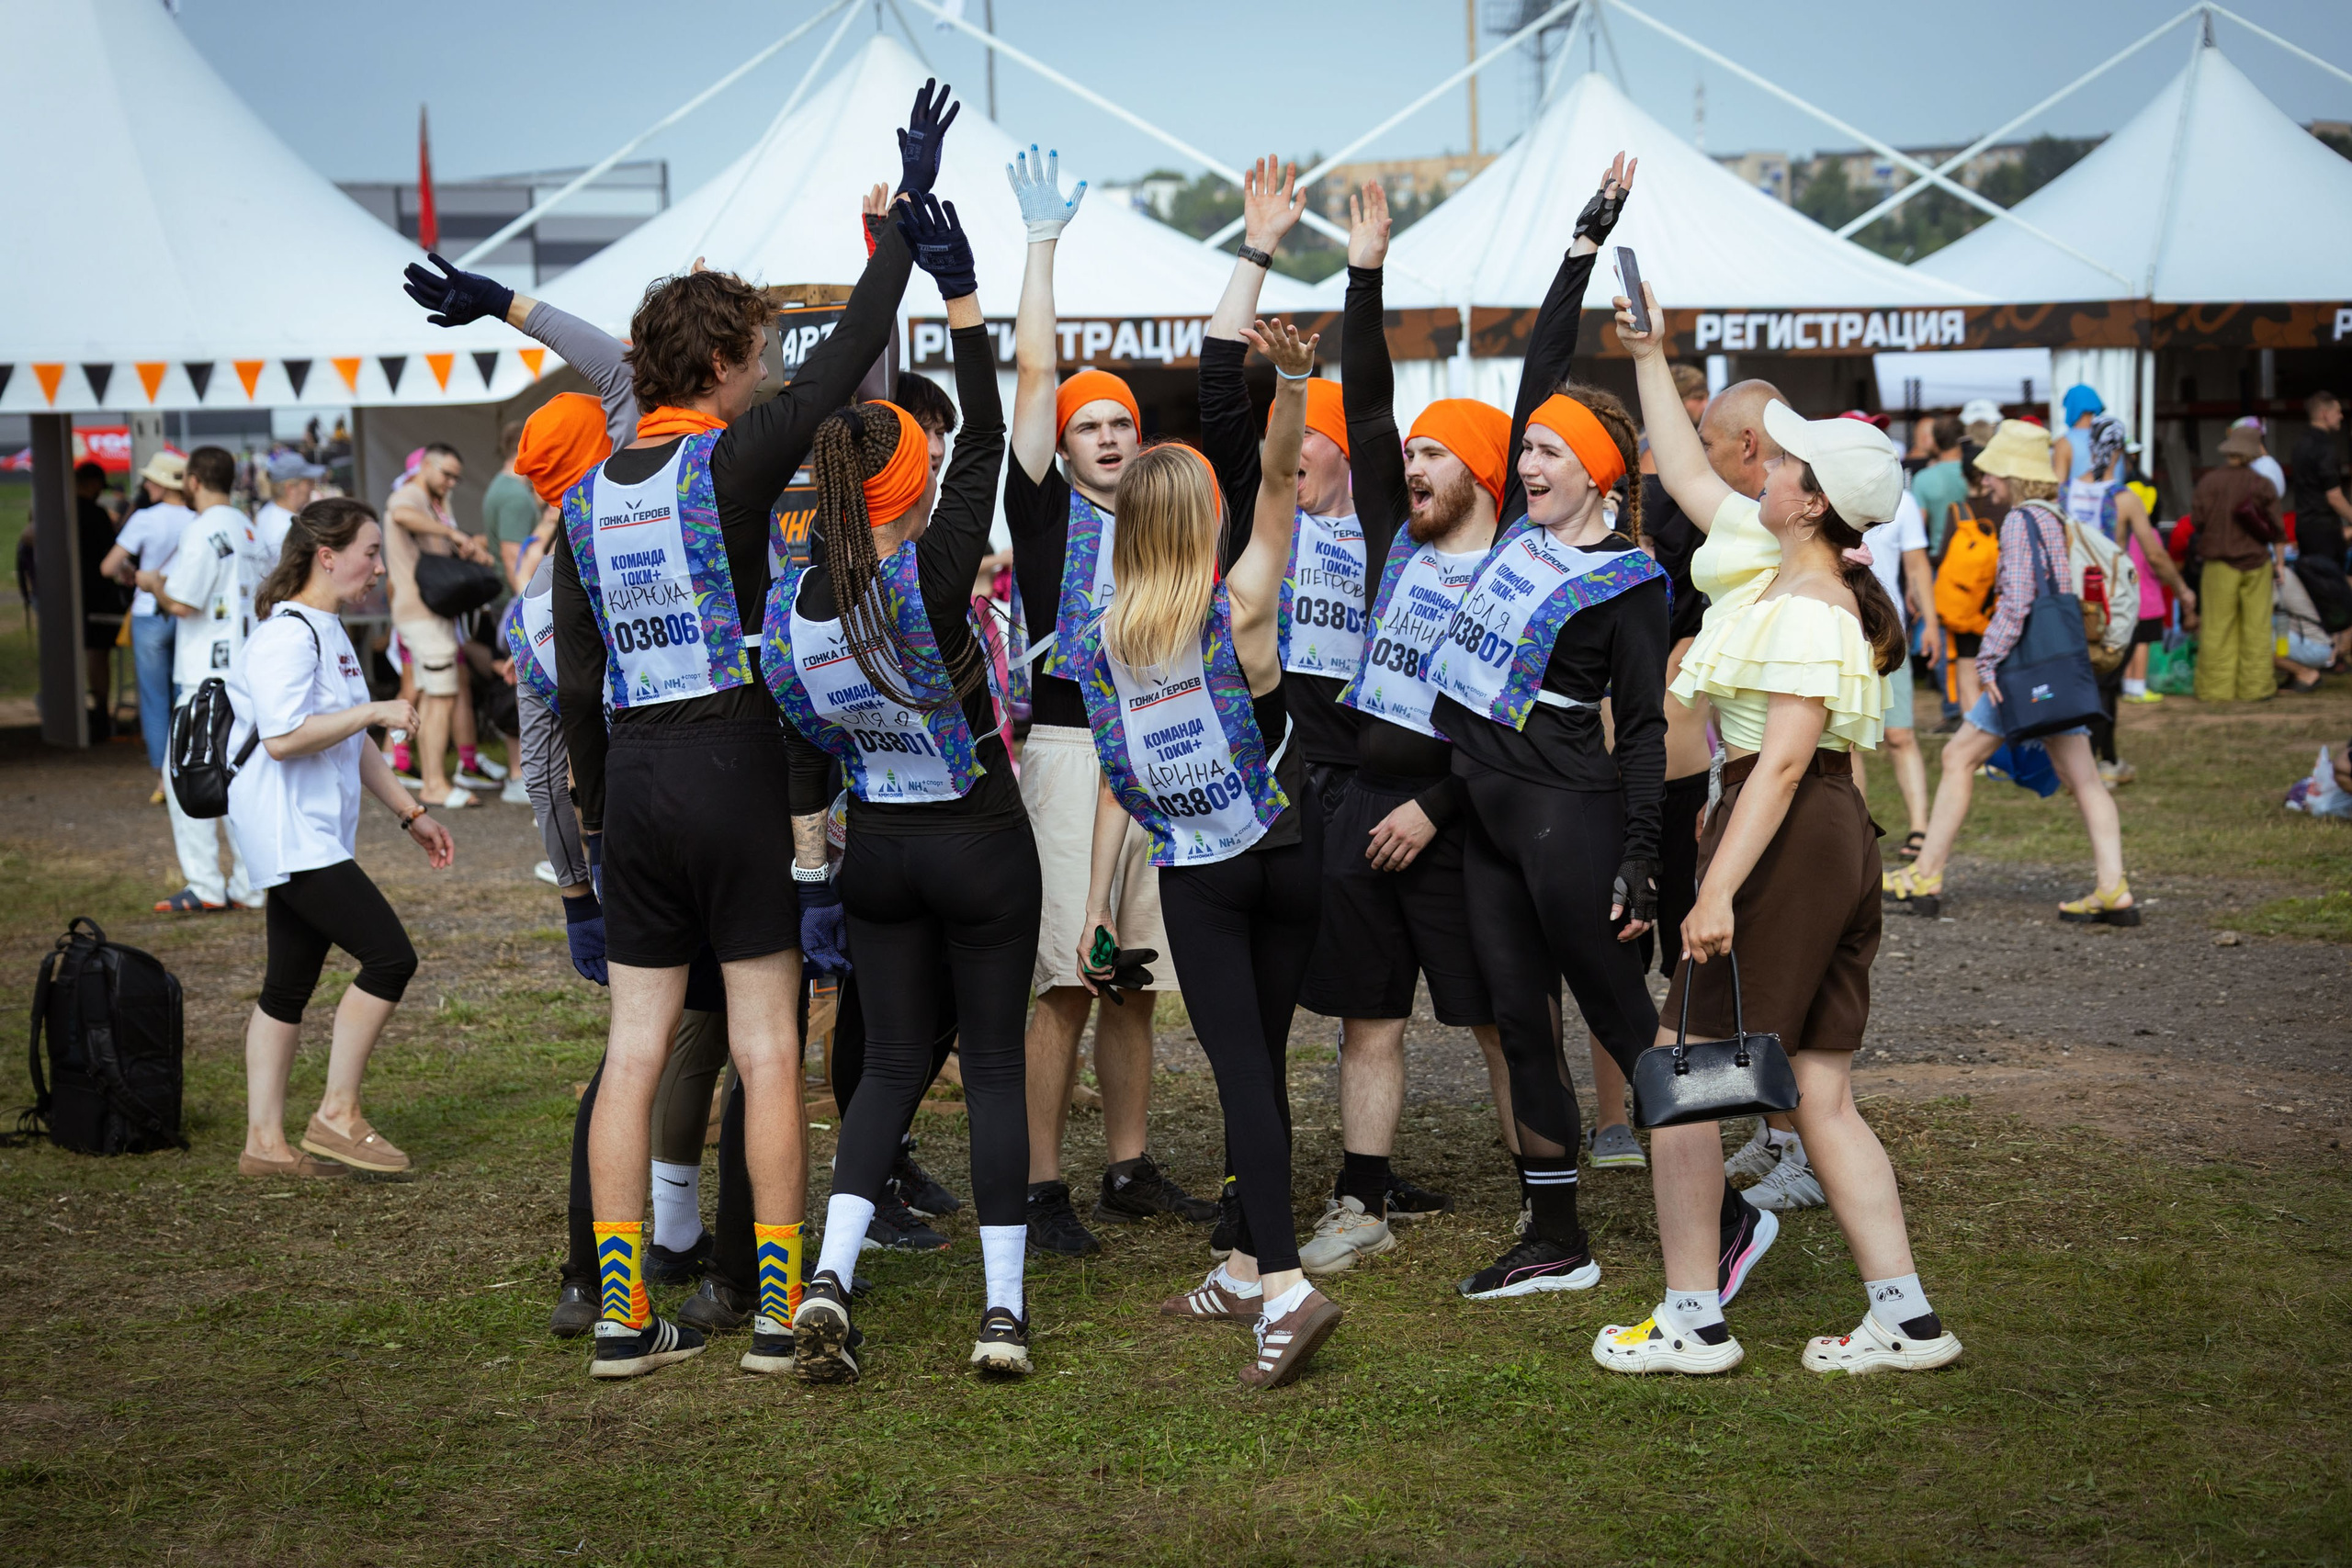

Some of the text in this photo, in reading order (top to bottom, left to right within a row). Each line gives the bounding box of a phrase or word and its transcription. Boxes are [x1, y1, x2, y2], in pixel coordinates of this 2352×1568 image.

[1695, 310, 1965, 351] РЕГИСТРАЦИЯ
[599, 506, 671, 527] ГОНКА ГЕРОЕВ
[611, 548, 666, 570] КОМАНДА
[1539, 549, 1570, 573] ГЕРОЕВ
[621, 570, 662, 587] 10КМ+
[1301, 568, 1365, 597] ПЕТРОВ
[1444, 575, 1471, 584] ГЕРОЕ
[1488, 578, 1516, 602] 10КМ+
[1495, 562, 1536, 596] КОМАНДА
[608, 582, 691, 614] КИРЮХА
[1408, 602, 1445, 622] 10КМ+
[534, 623, 554, 644] ГОНК
[615, 612, 700, 654] 03806
[1448, 610, 1514, 669] 03807
[802, 649, 839, 667] ГОНКА
[1129, 677, 1202, 708] ГОНКА ГЕРОЕВ
[854, 728, 936, 757] 03801
[1143, 717, 1204, 750] КОМАНДА
[1157, 740, 1203, 762] 10КМ+
[1148, 759, 1226, 792] АРИНА
[1157, 772, 1242, 818] 03809
